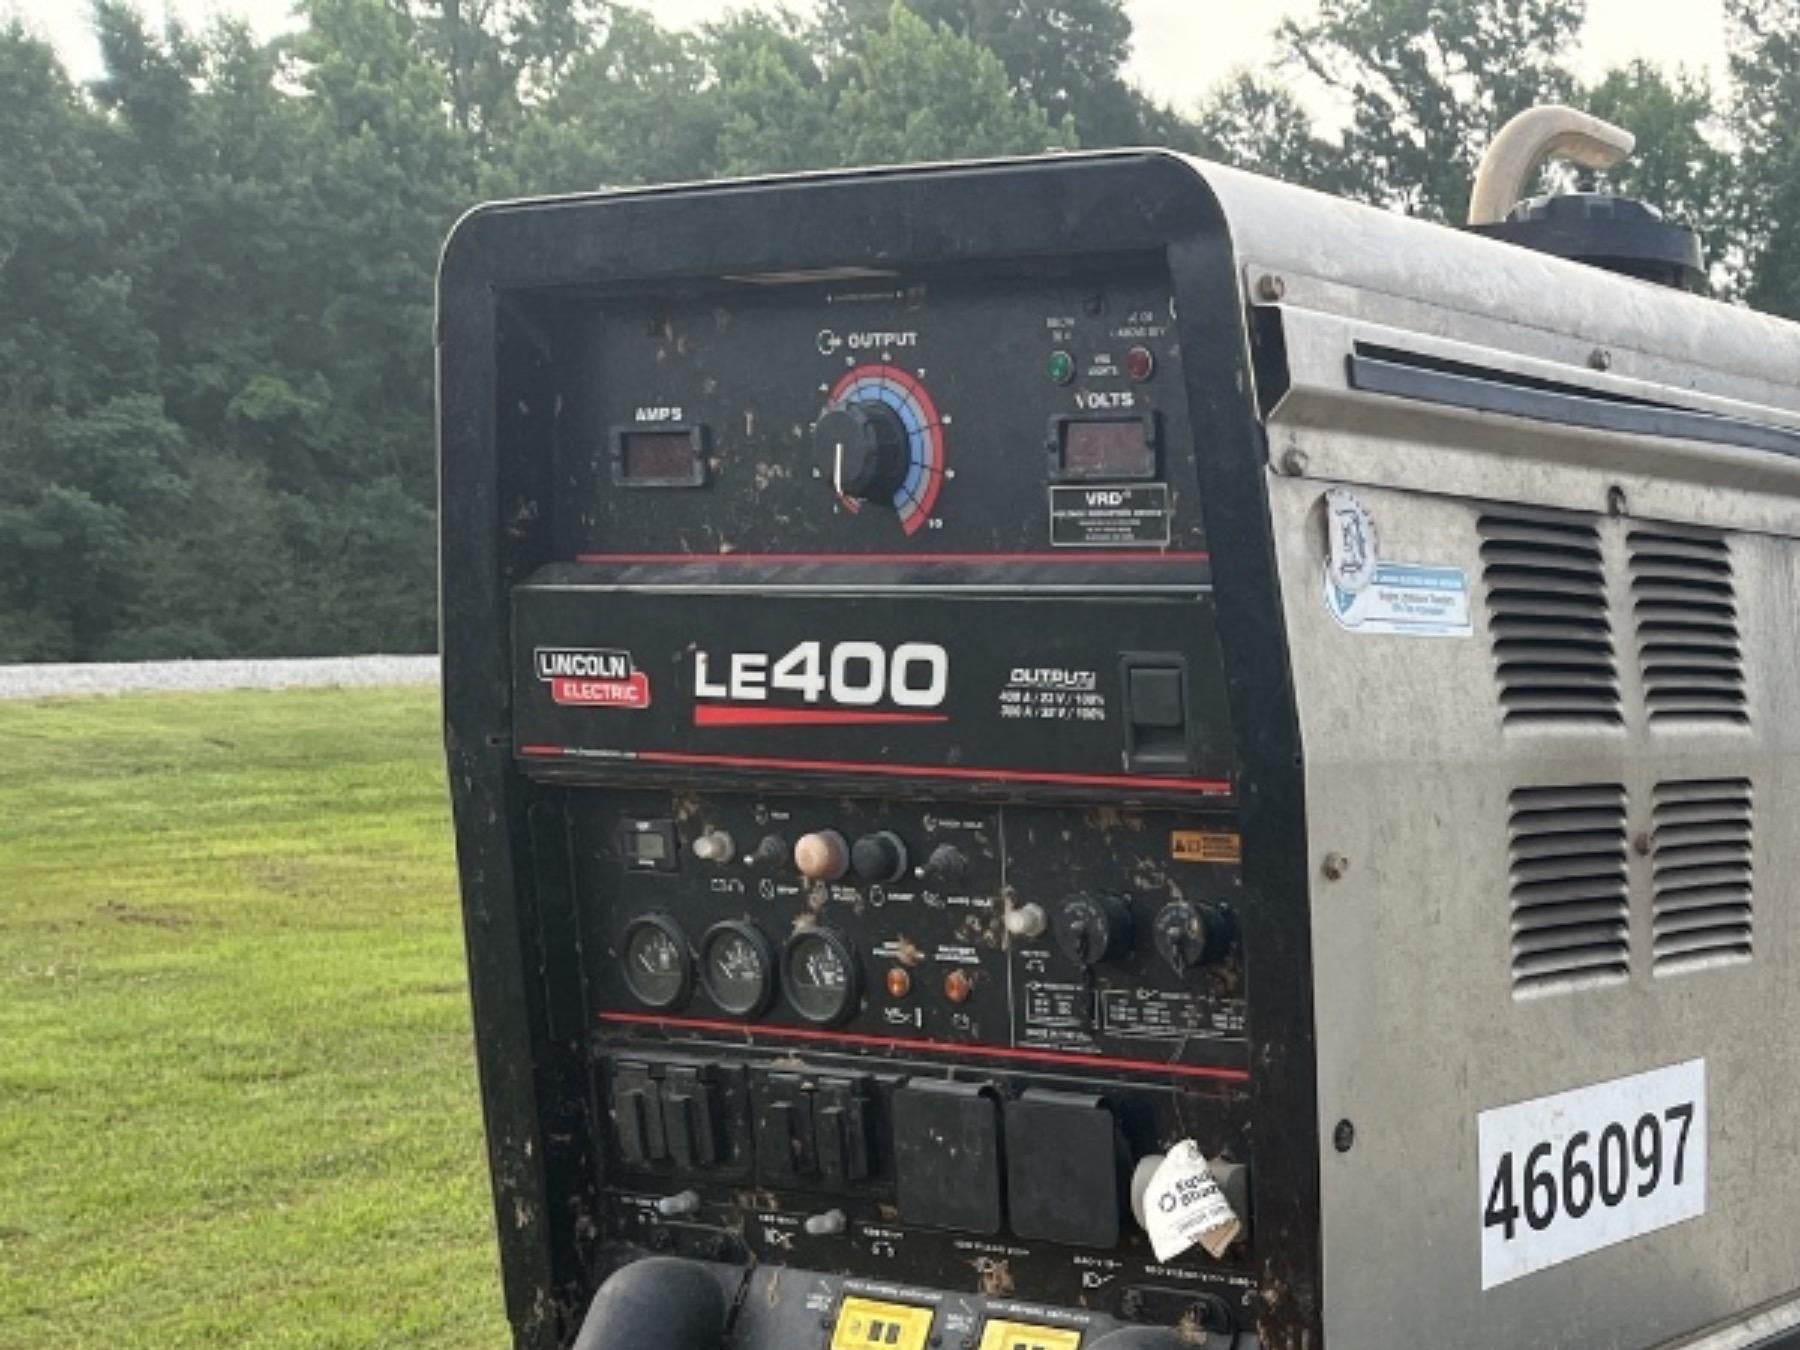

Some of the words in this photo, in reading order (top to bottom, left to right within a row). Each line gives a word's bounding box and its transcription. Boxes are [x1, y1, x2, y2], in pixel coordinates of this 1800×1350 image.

[849, 331, 918, 348] OUTPUT
[1075, 391, 1135, 409] VOLTS
[635, 406, 682, 422] AMPS
[538, 653, 627, 680] LINCOLN
[695, 640, 949, 707] LE400
[562, 682, 639, 702] ELECTRIC
[1484, 1101, 1694, 1241] 466097
